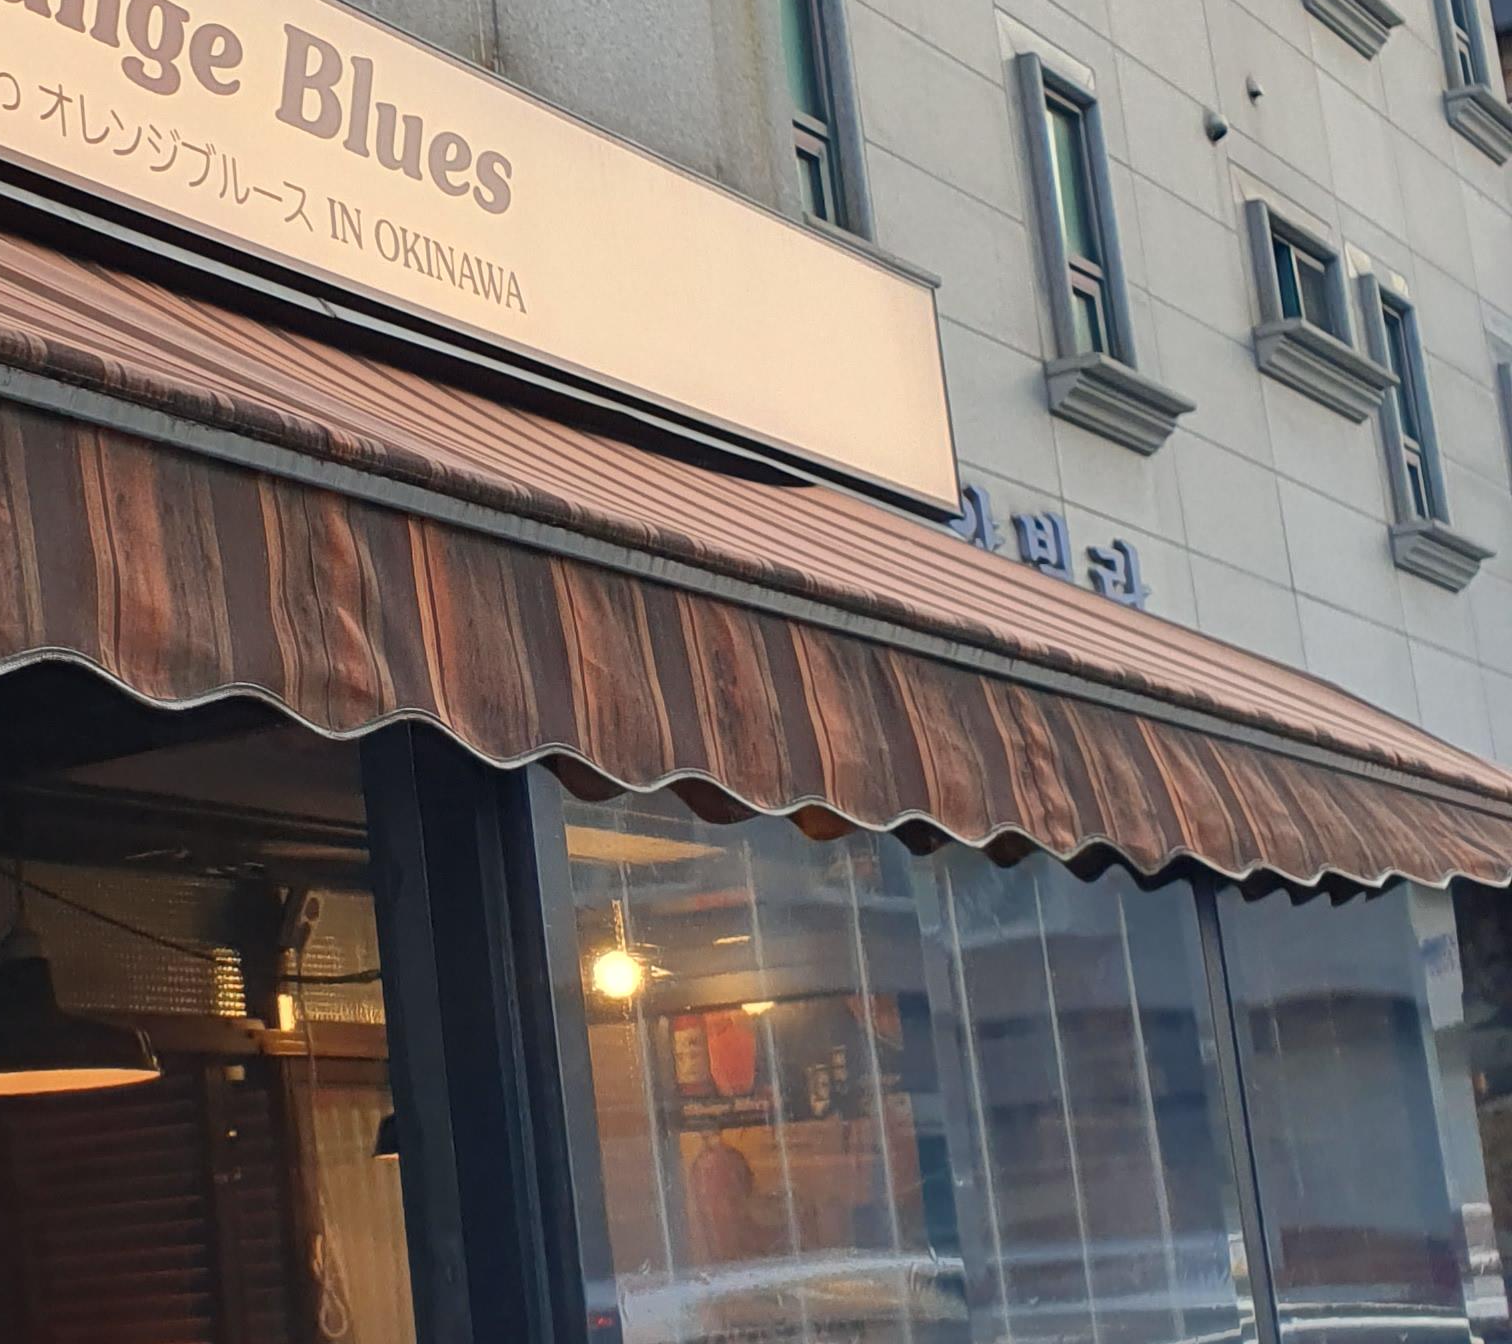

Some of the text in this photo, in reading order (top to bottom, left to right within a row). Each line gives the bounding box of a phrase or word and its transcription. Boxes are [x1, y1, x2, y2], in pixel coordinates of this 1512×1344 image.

[39, 83, 314, 233] オレンジブルース
[326, 196, 364, 251] IN
[374, 218, 528, 314] OKINAWA
[274, 22, 514, 215] Blues
